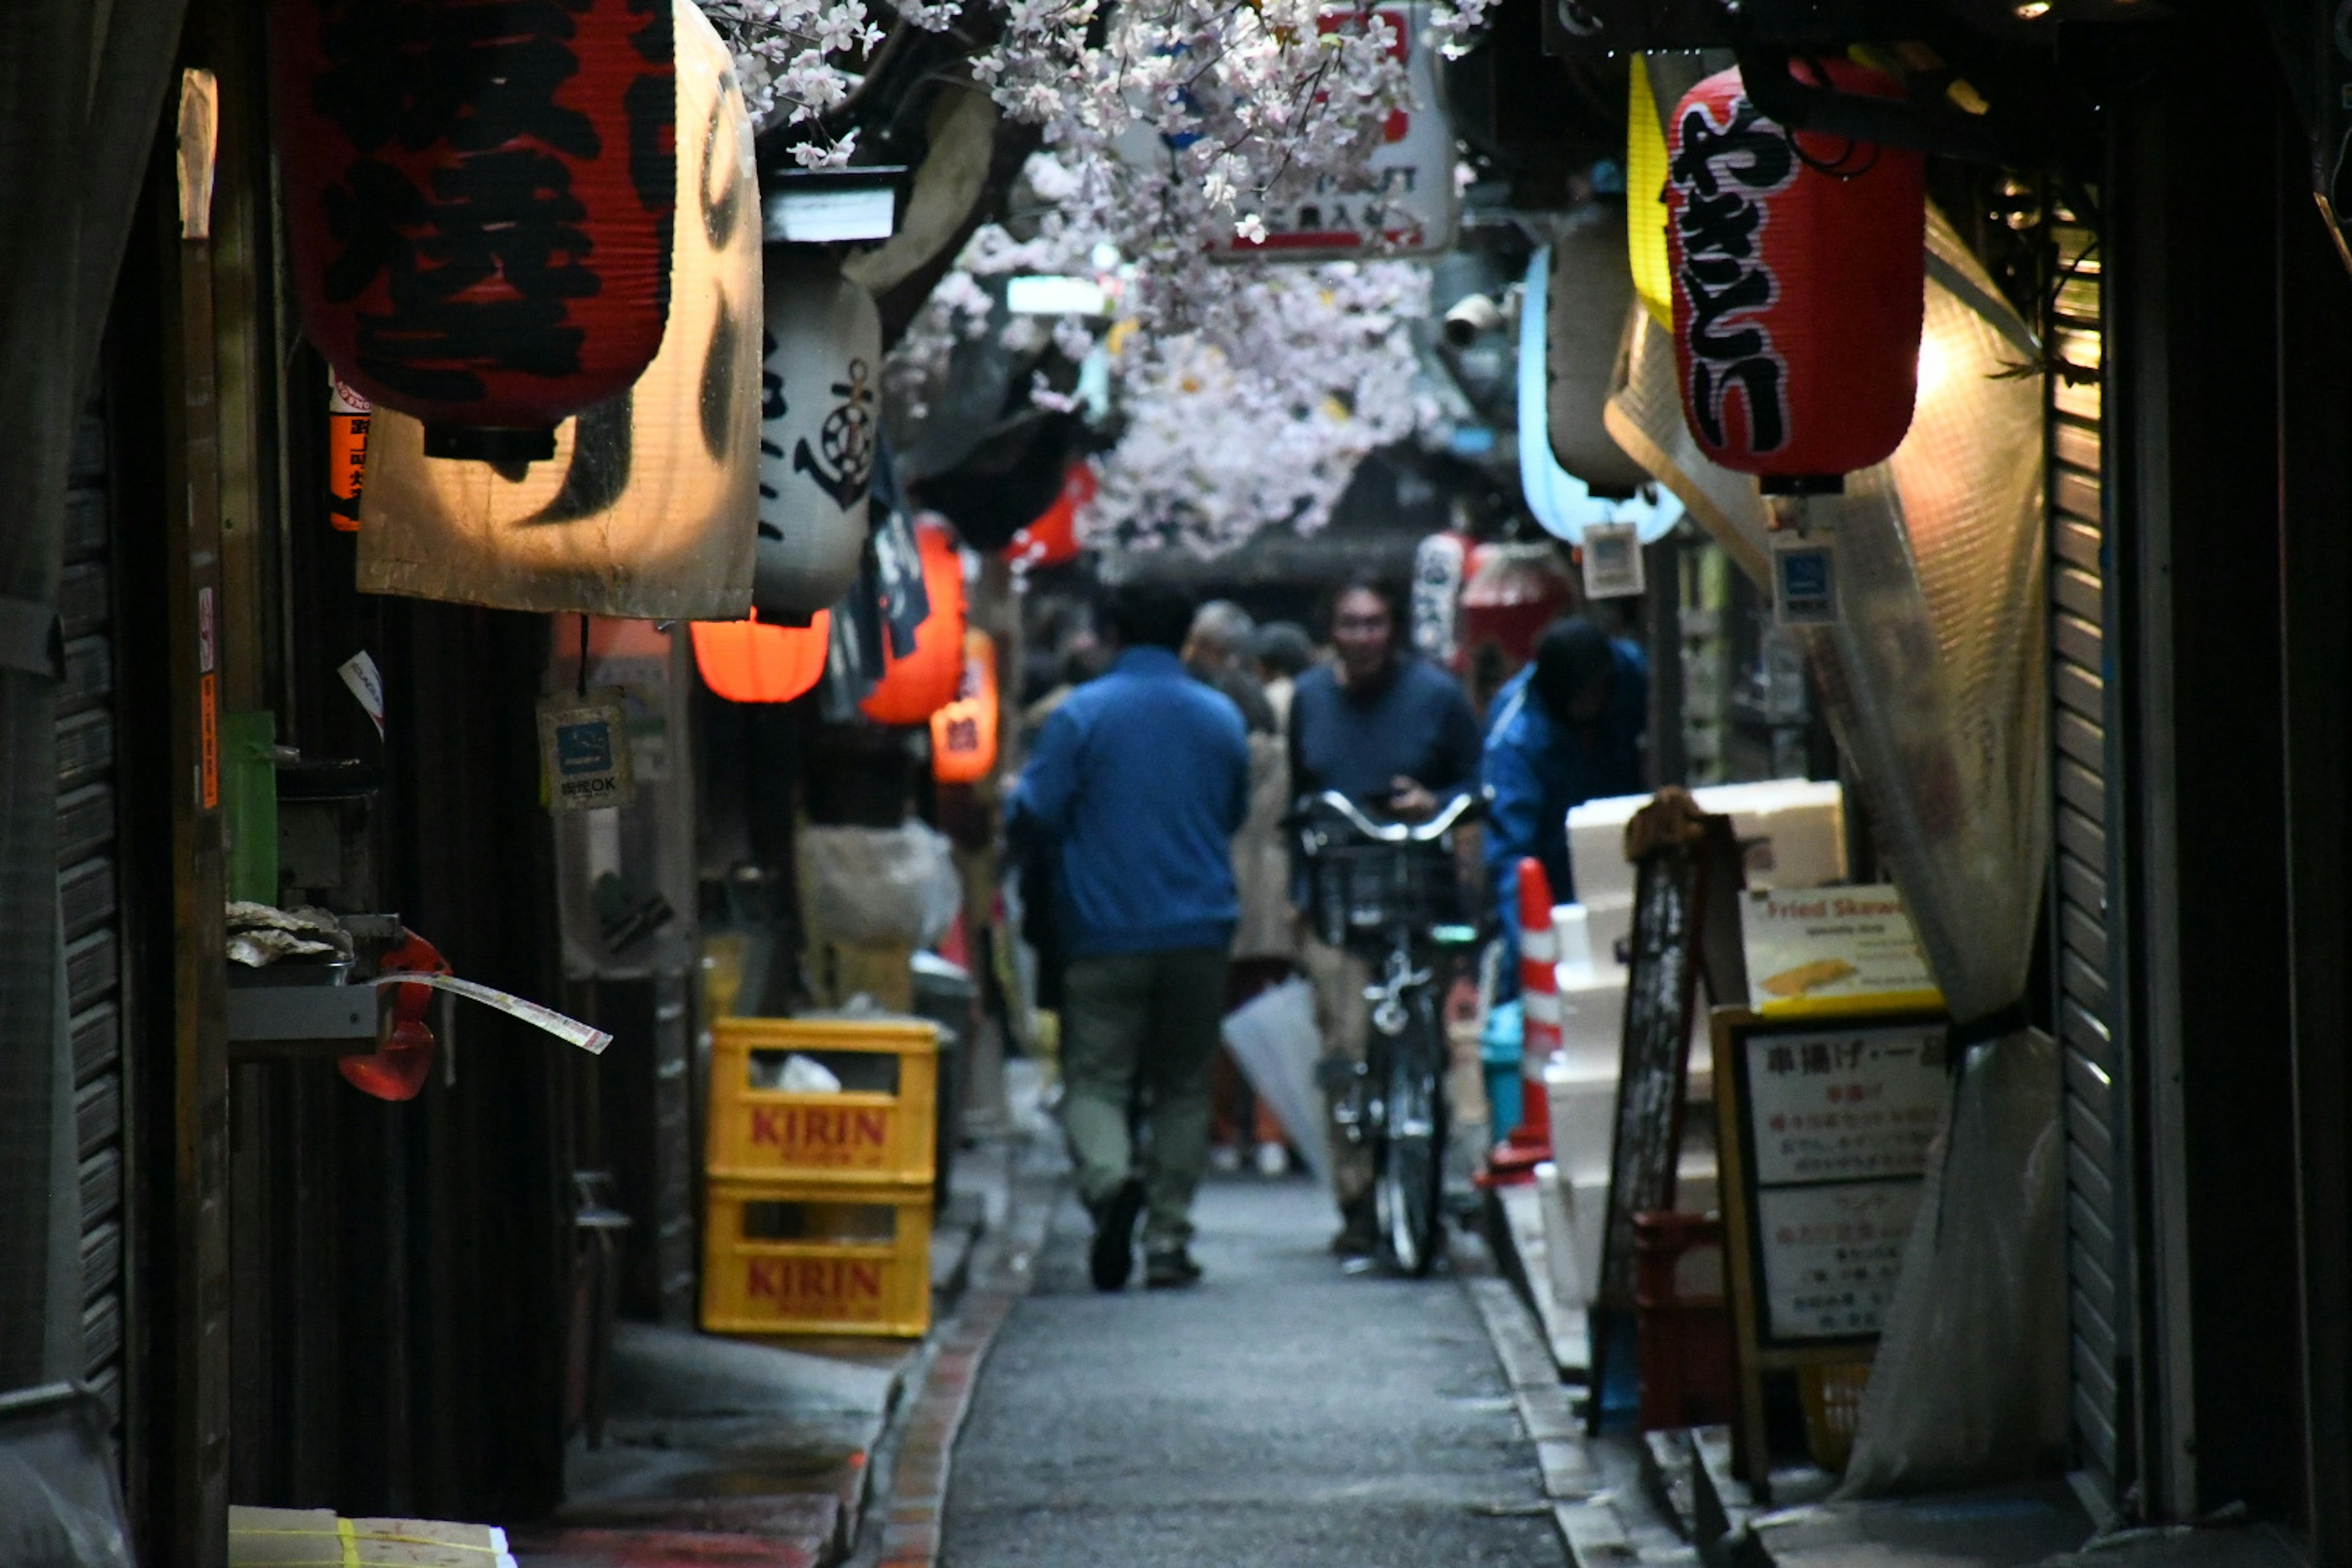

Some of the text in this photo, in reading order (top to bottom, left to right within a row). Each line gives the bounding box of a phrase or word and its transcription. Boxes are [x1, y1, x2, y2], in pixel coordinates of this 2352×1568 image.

[1670, 93, 1798, 453] やきとり
[1768, 899, 1826, 918] Fried
[753, 1107, 886, 1146] KIRIN
[748, 1259, 882, 1298] KIRIN
